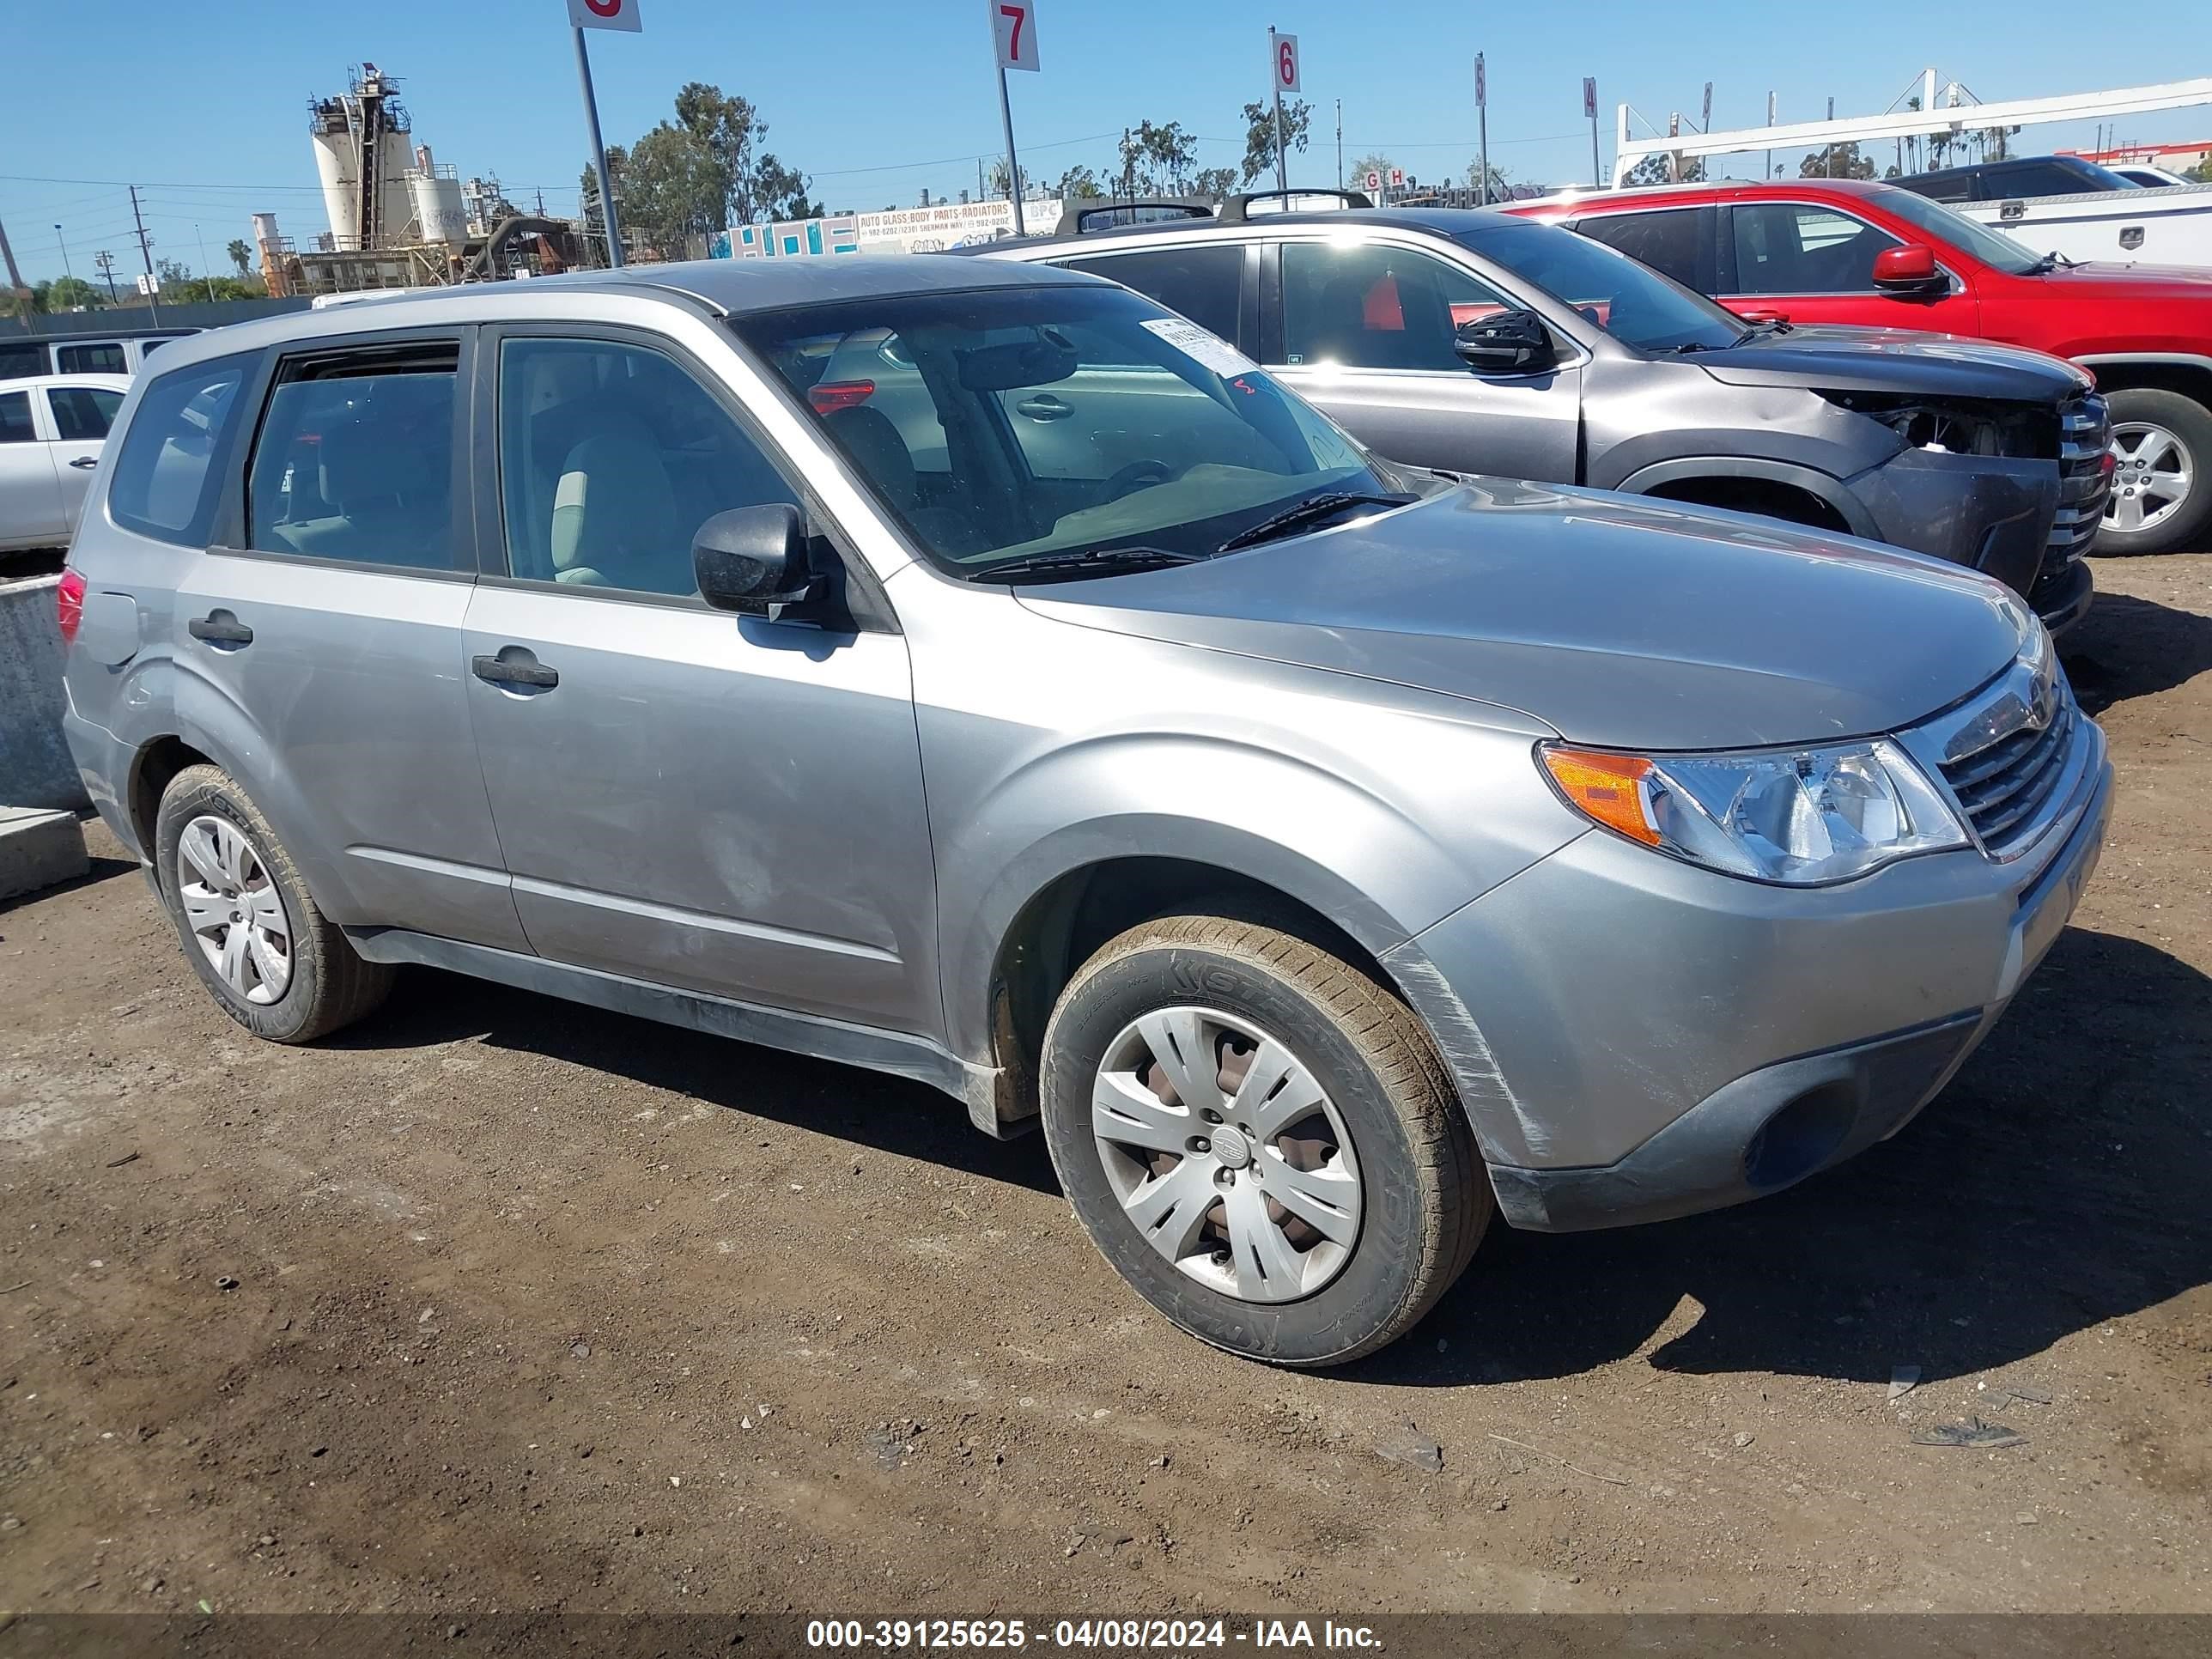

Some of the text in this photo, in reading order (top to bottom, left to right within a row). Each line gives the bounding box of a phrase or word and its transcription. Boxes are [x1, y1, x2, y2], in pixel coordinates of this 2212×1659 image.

[1000, 4, 1025, 60] 7
[1279, 41, 1294, 85] 6
[1476, 63, 1484, 100] 5
[1586, 82, 1595, 113] 4
[1704, 88, 1711, 114] 3
[1367, 173, 1378, 188] G
[1392, 169, 1402, 184] H
[1030, 204, 1057, 217] BPC
[860, 216, 880, 228] AUTO
[920, 222, 949, 232] SHERMAN
